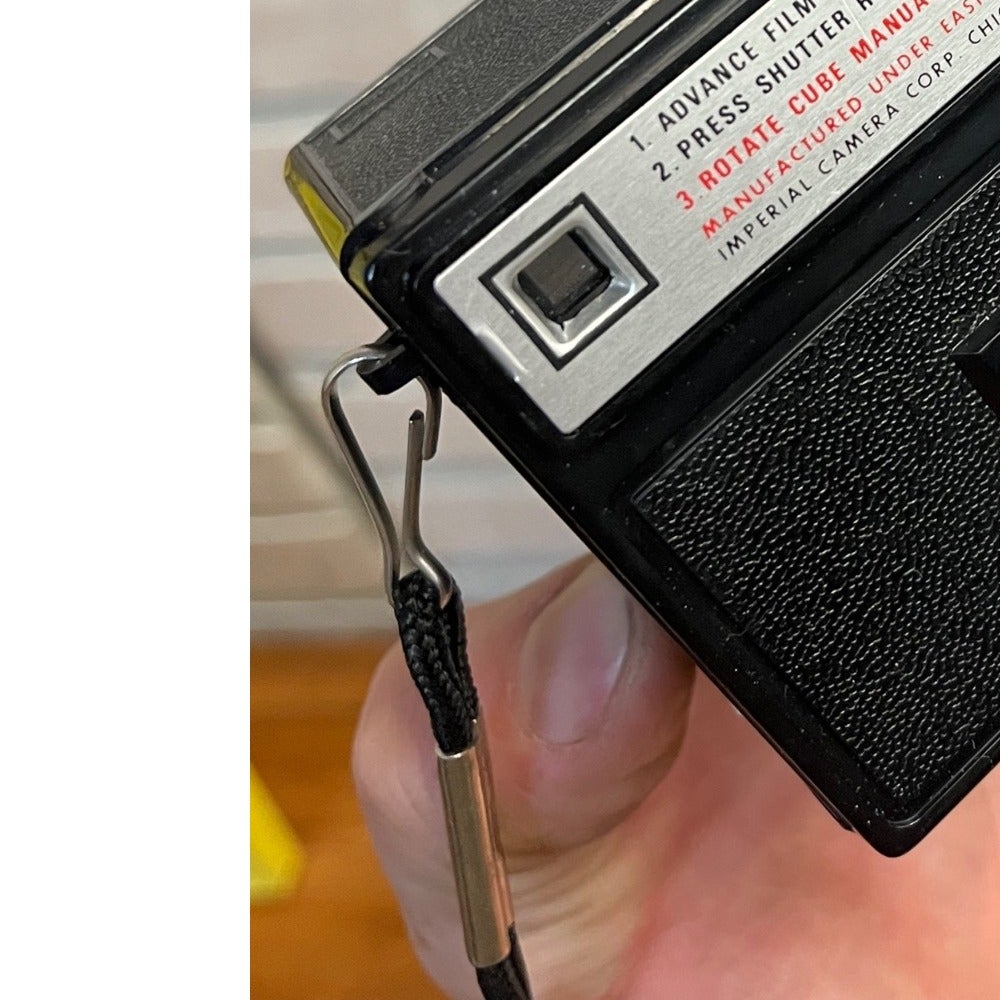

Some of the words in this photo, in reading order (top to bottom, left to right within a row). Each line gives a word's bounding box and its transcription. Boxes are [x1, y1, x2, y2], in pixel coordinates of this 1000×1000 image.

[630, 135, 652, 151] 1.
[658, 41, 759, 132] ADVANCE
[652, 161, 679, 182] 2.
[676, 94, 750, 159] PRESS
[755, 10, 851, 94] SHUTTER
[698, 115, 784, 190] ROTATE
[788, 62, 845, 115] CUBE
[702, 97, 861, 239] MANUFACTURED
[868, 36, 934, 94] UNDER
[718, 179, 812, 260] IMPERIAL
[818, 104, 899, 175] CAMERA
